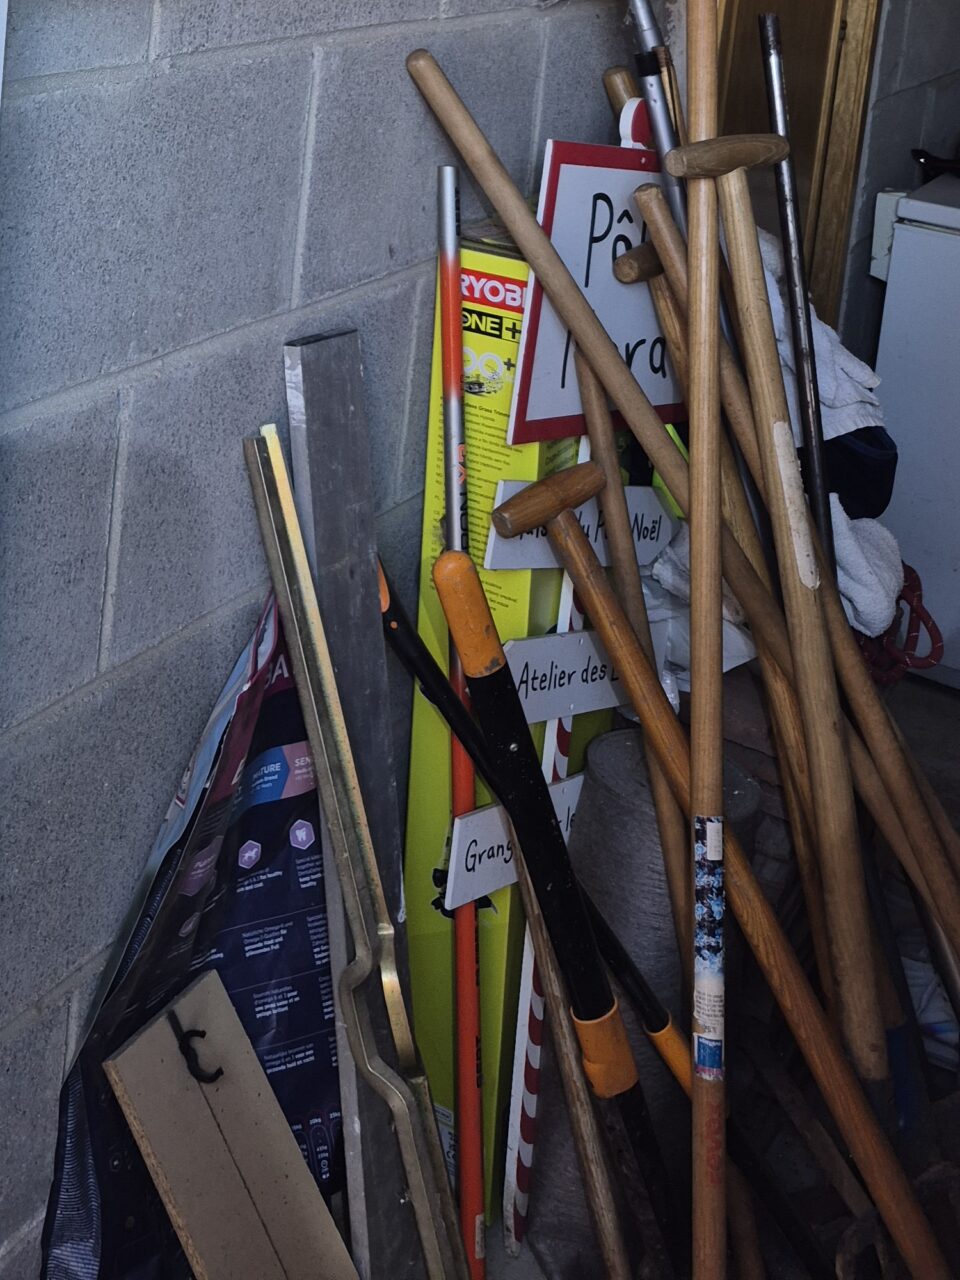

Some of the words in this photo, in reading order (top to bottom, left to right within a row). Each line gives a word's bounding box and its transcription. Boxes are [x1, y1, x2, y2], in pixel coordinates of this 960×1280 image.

[585, 192, 648, 288] Pô
[517, 660, 577, 700] Atelier
[581, 655, 608, 684] des
